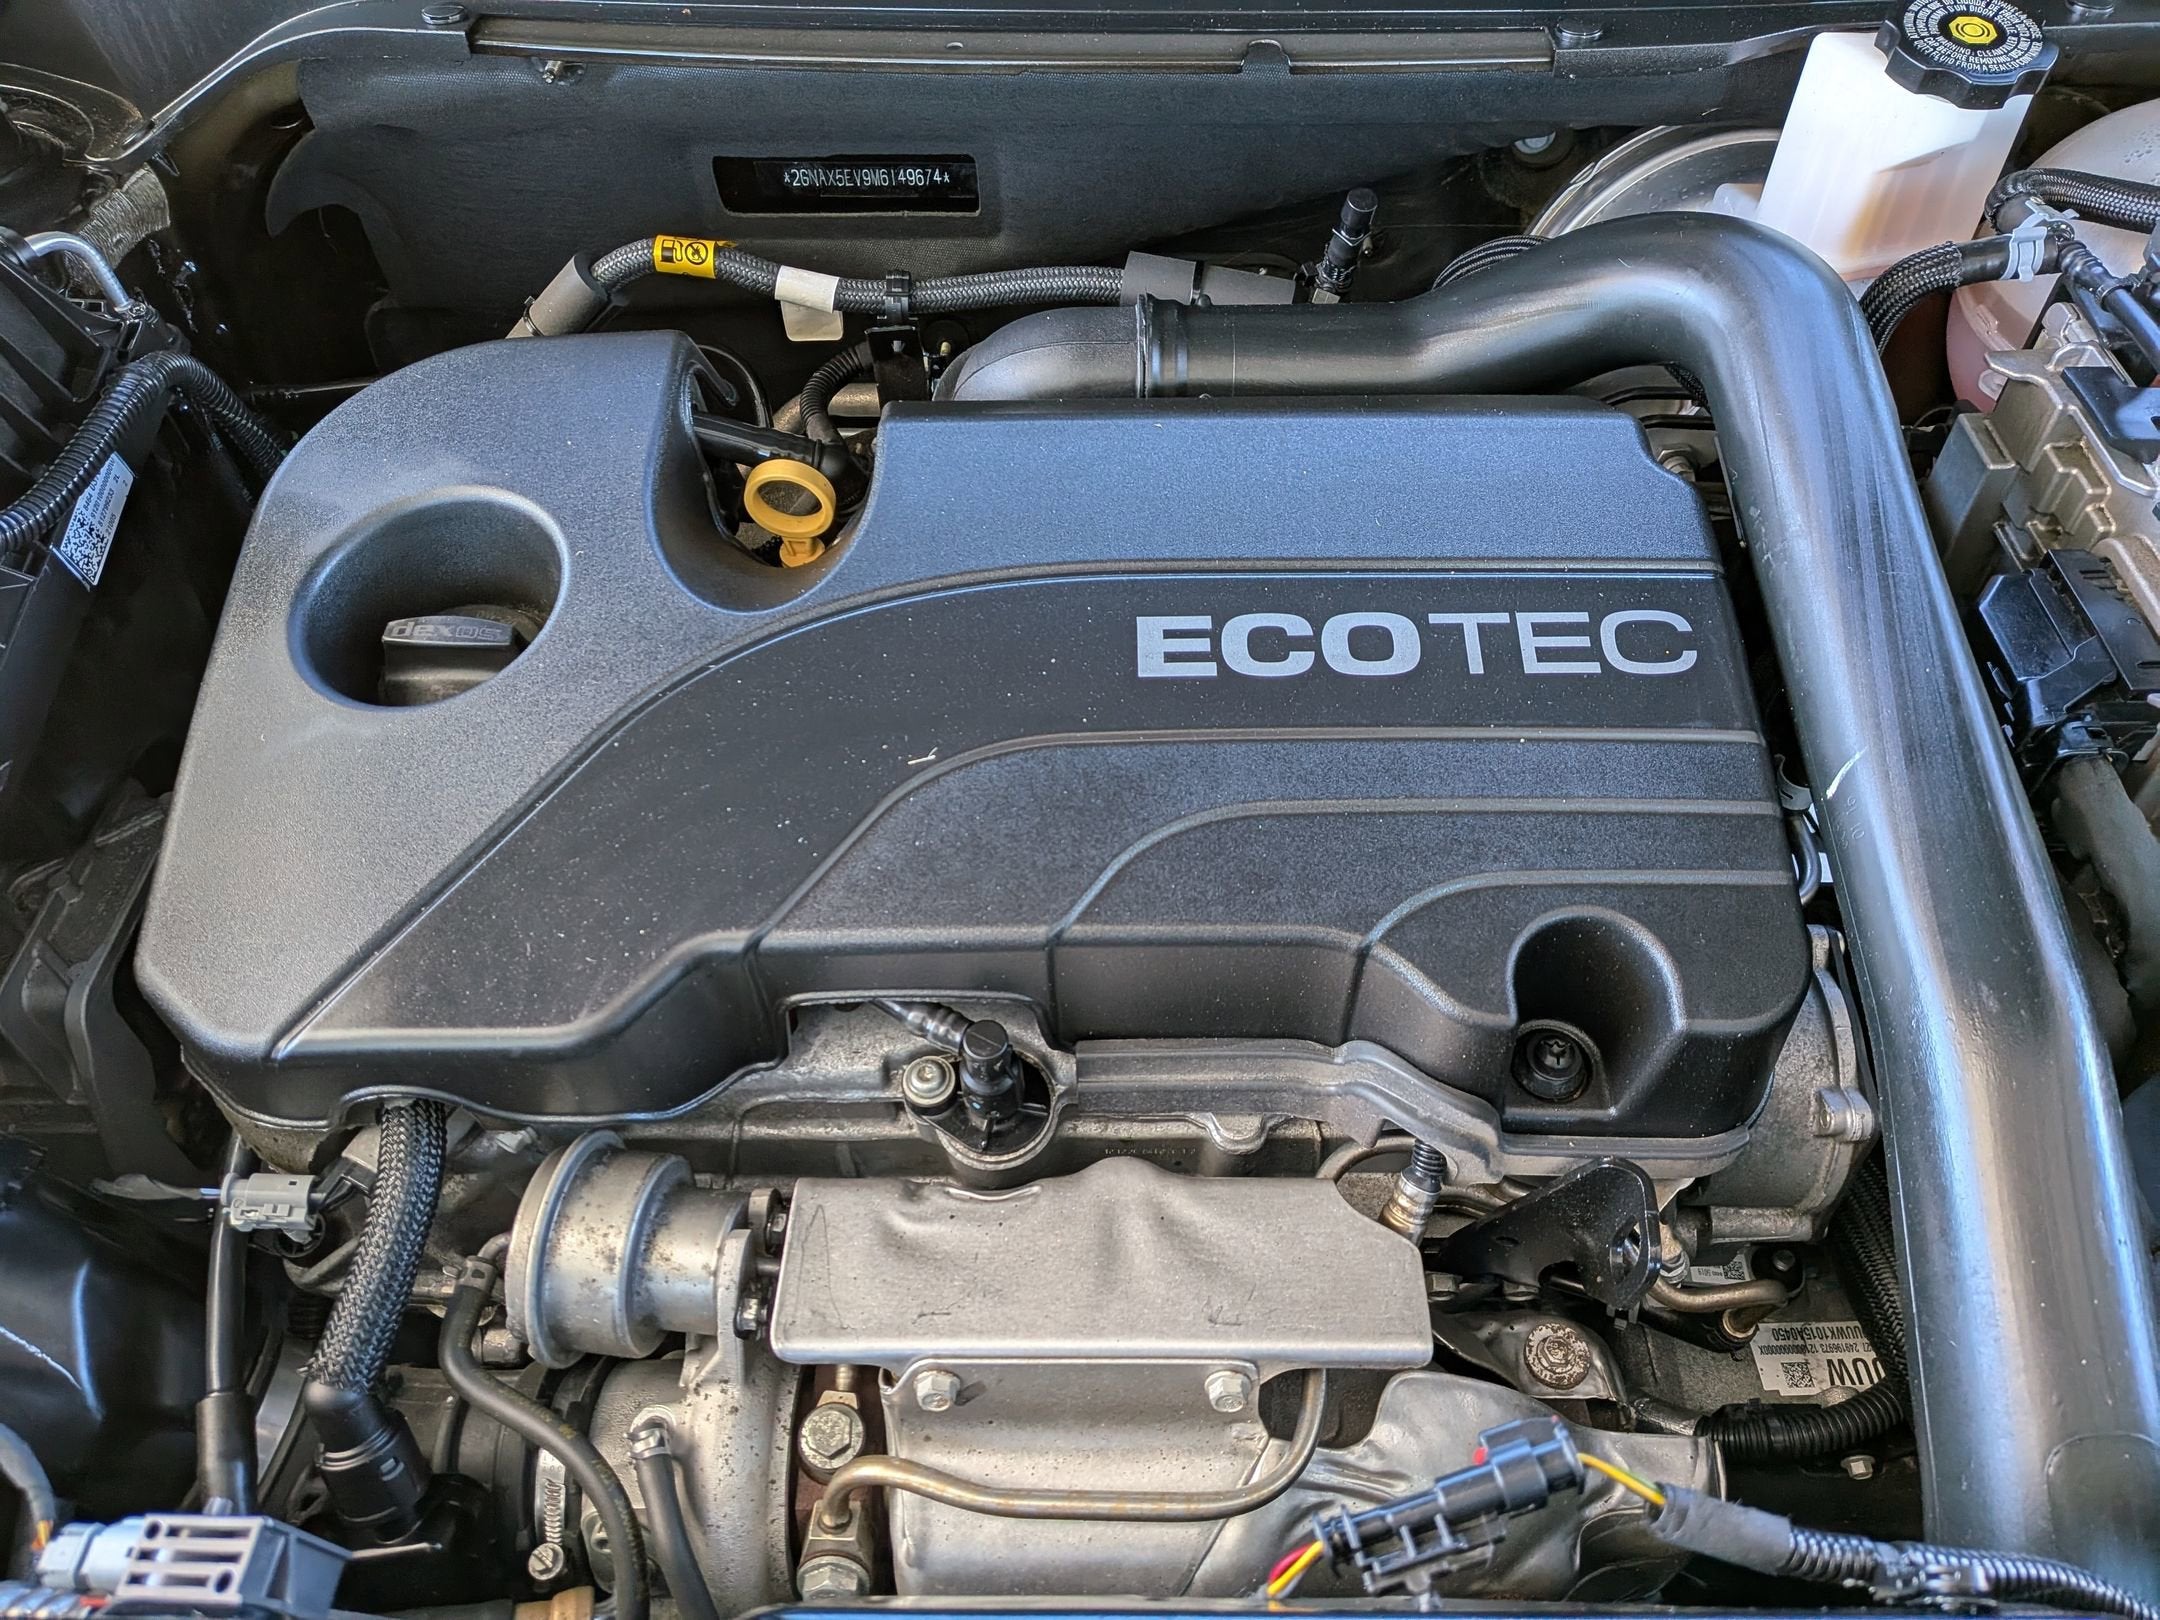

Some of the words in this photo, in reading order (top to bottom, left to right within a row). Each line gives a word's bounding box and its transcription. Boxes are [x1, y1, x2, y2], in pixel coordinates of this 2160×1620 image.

[1922, 36, 1941, 48] CAP
[1934, 45, 1967, 61] BEFORE
[1976, 46, 2005, 57] CLEAN
[1927, 50, 1955, 66] FLUID
[1953, 60, 1981, 72] FROM
[1988, 60, 2020, 71] SEALED
[391, 622, 503, 640] dexos
[1136, 610, 1698, 678] ECOTEC
[1771, 1325, 1863, 1341] UUWK1015A0450
